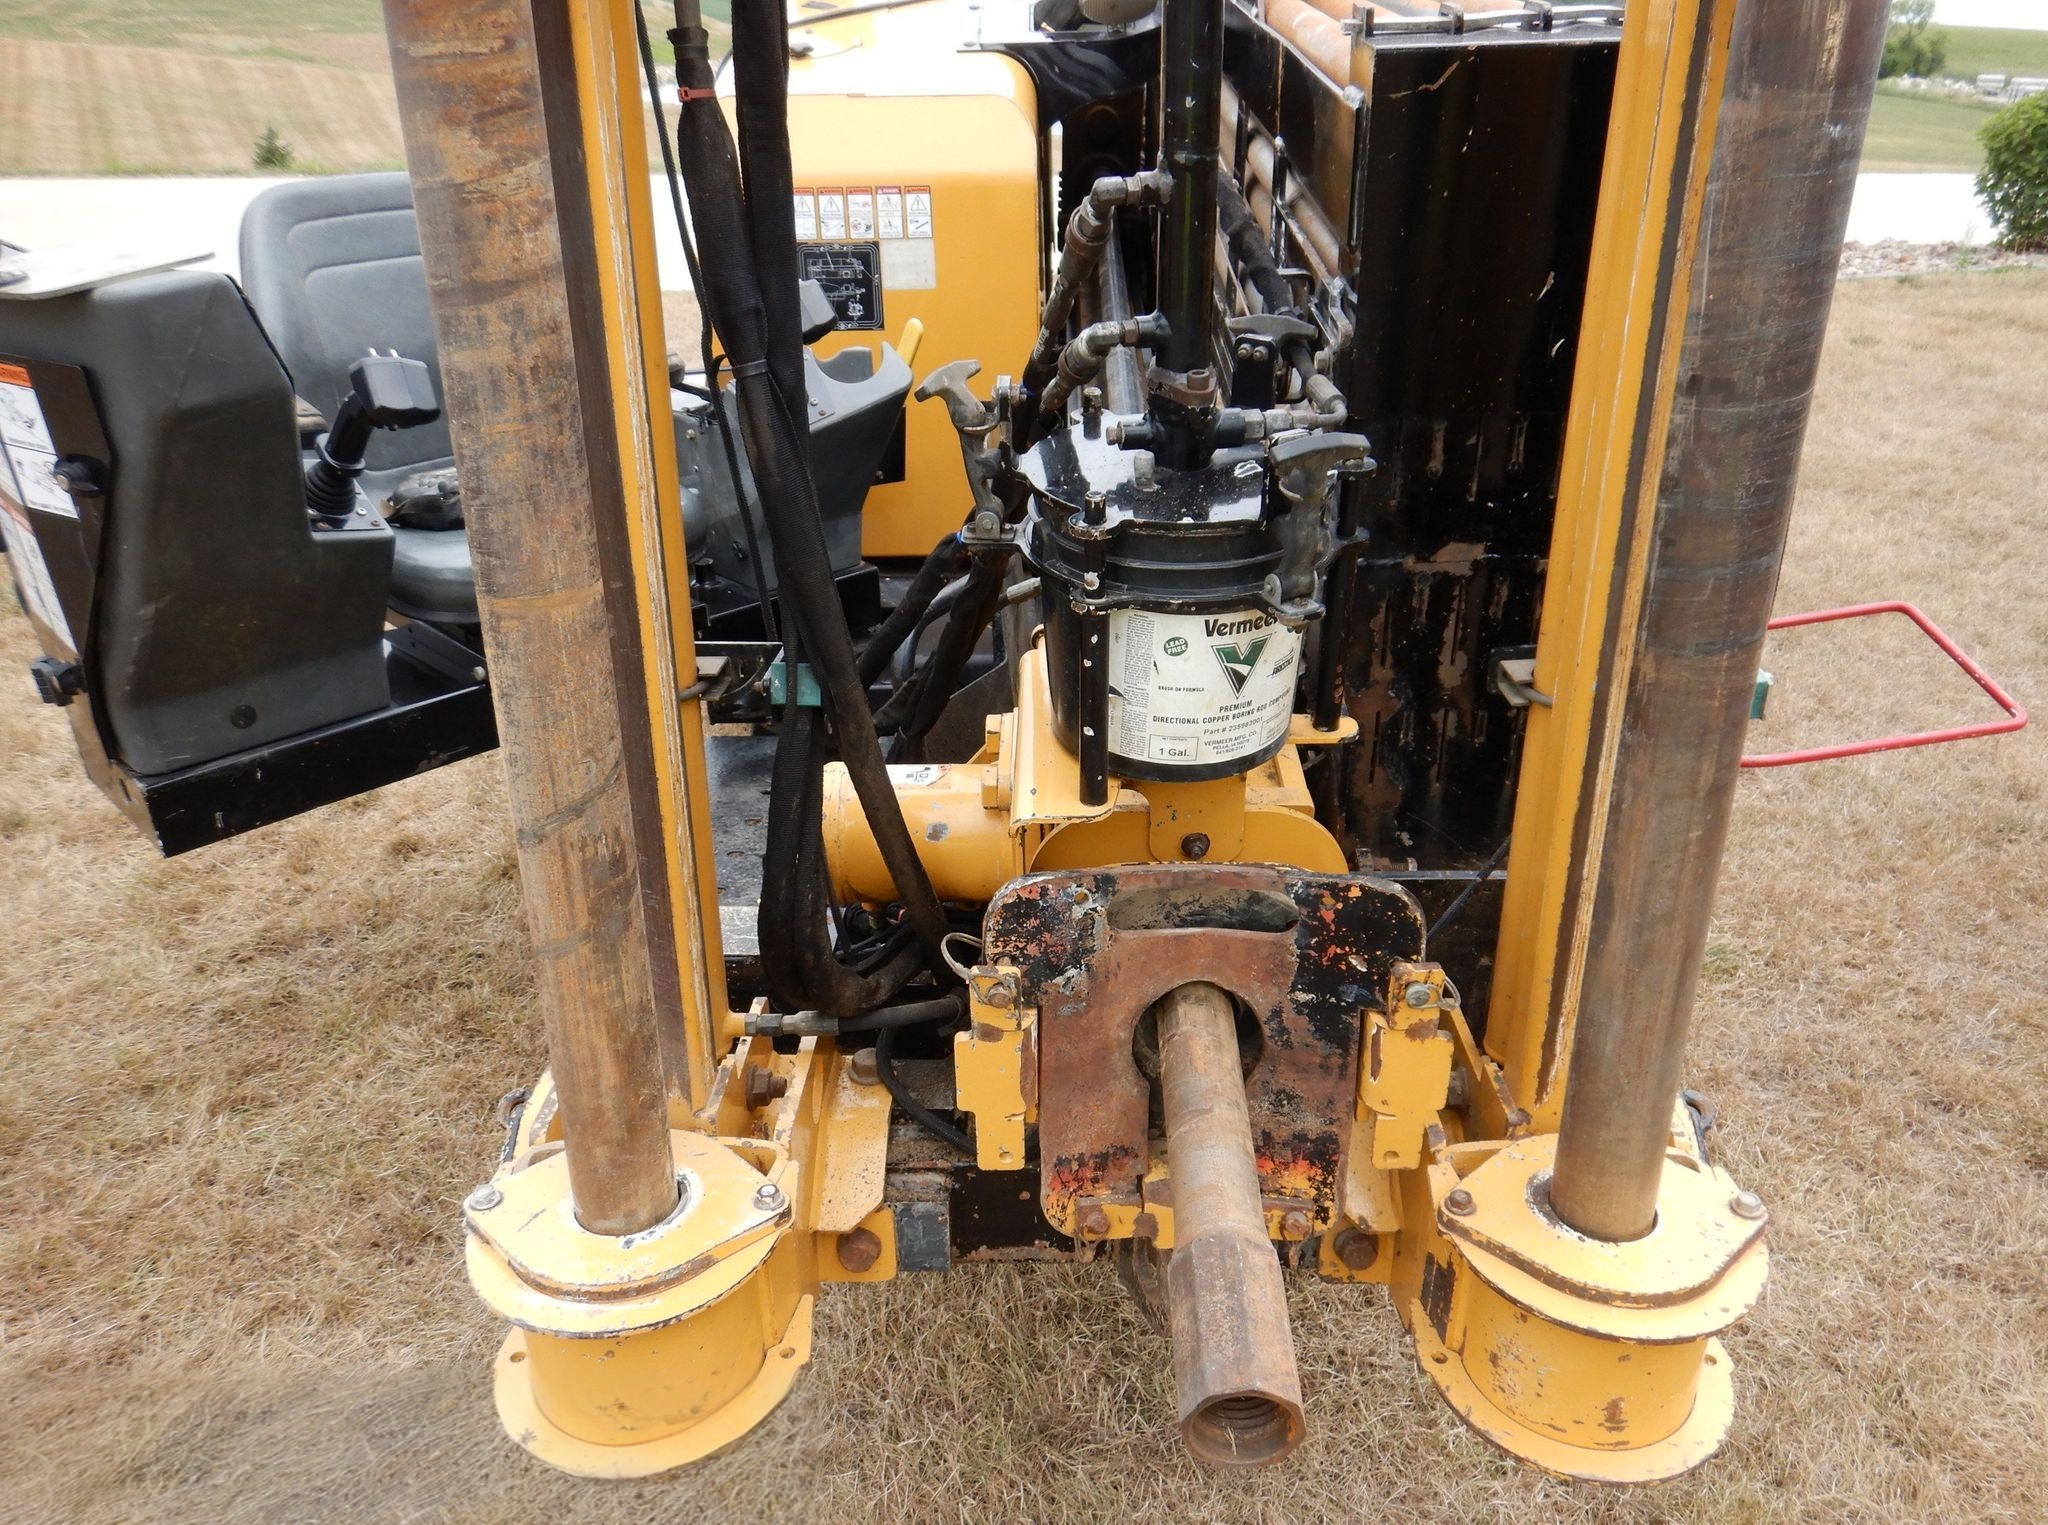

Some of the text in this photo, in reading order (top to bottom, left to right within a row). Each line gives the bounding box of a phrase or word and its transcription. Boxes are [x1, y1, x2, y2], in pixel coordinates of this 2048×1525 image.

[1166, 638, 1185, 648] LEAD
[1167, 644, 1187, 655] FREE
[1219, 700, 1253, 713] PREMIUM
[1153, 715, 1199, 725] DIRECTIONAL
[1202, 714, 1230, 724] COPPER
[1232, 708, 1255, 720] BORING
[1256, 703, 1267, 713] ROD
[1204, 737, 1233, 746] VERMEER
[1168, 748, 1190, 757] Gal.
